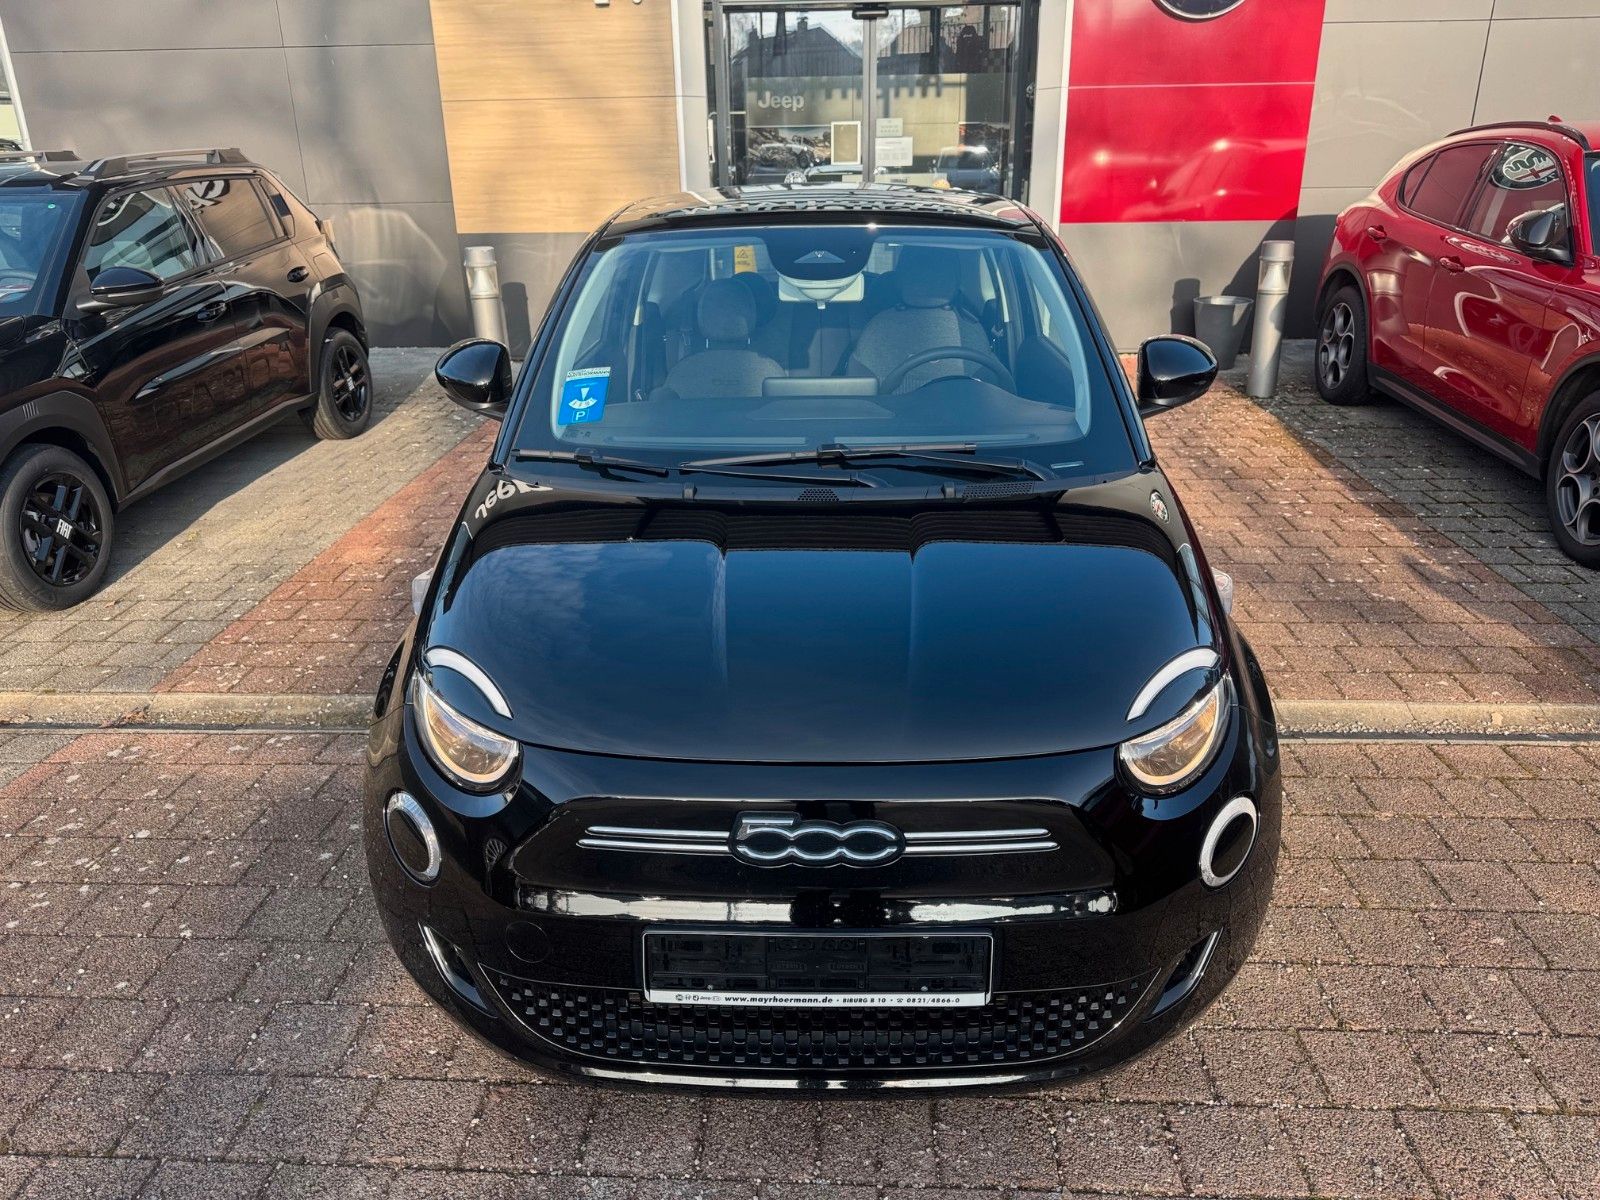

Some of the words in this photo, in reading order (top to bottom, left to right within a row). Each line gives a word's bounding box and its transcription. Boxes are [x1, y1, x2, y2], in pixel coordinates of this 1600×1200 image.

[757, 91, 805, 111] Jeep
[575, 411, 586, 421] P
[56, 518, 74, 540] FIAT
[736, 818, 899, 860] 500
[724, 994, 833, 1005] www.mayrhoermann.de
